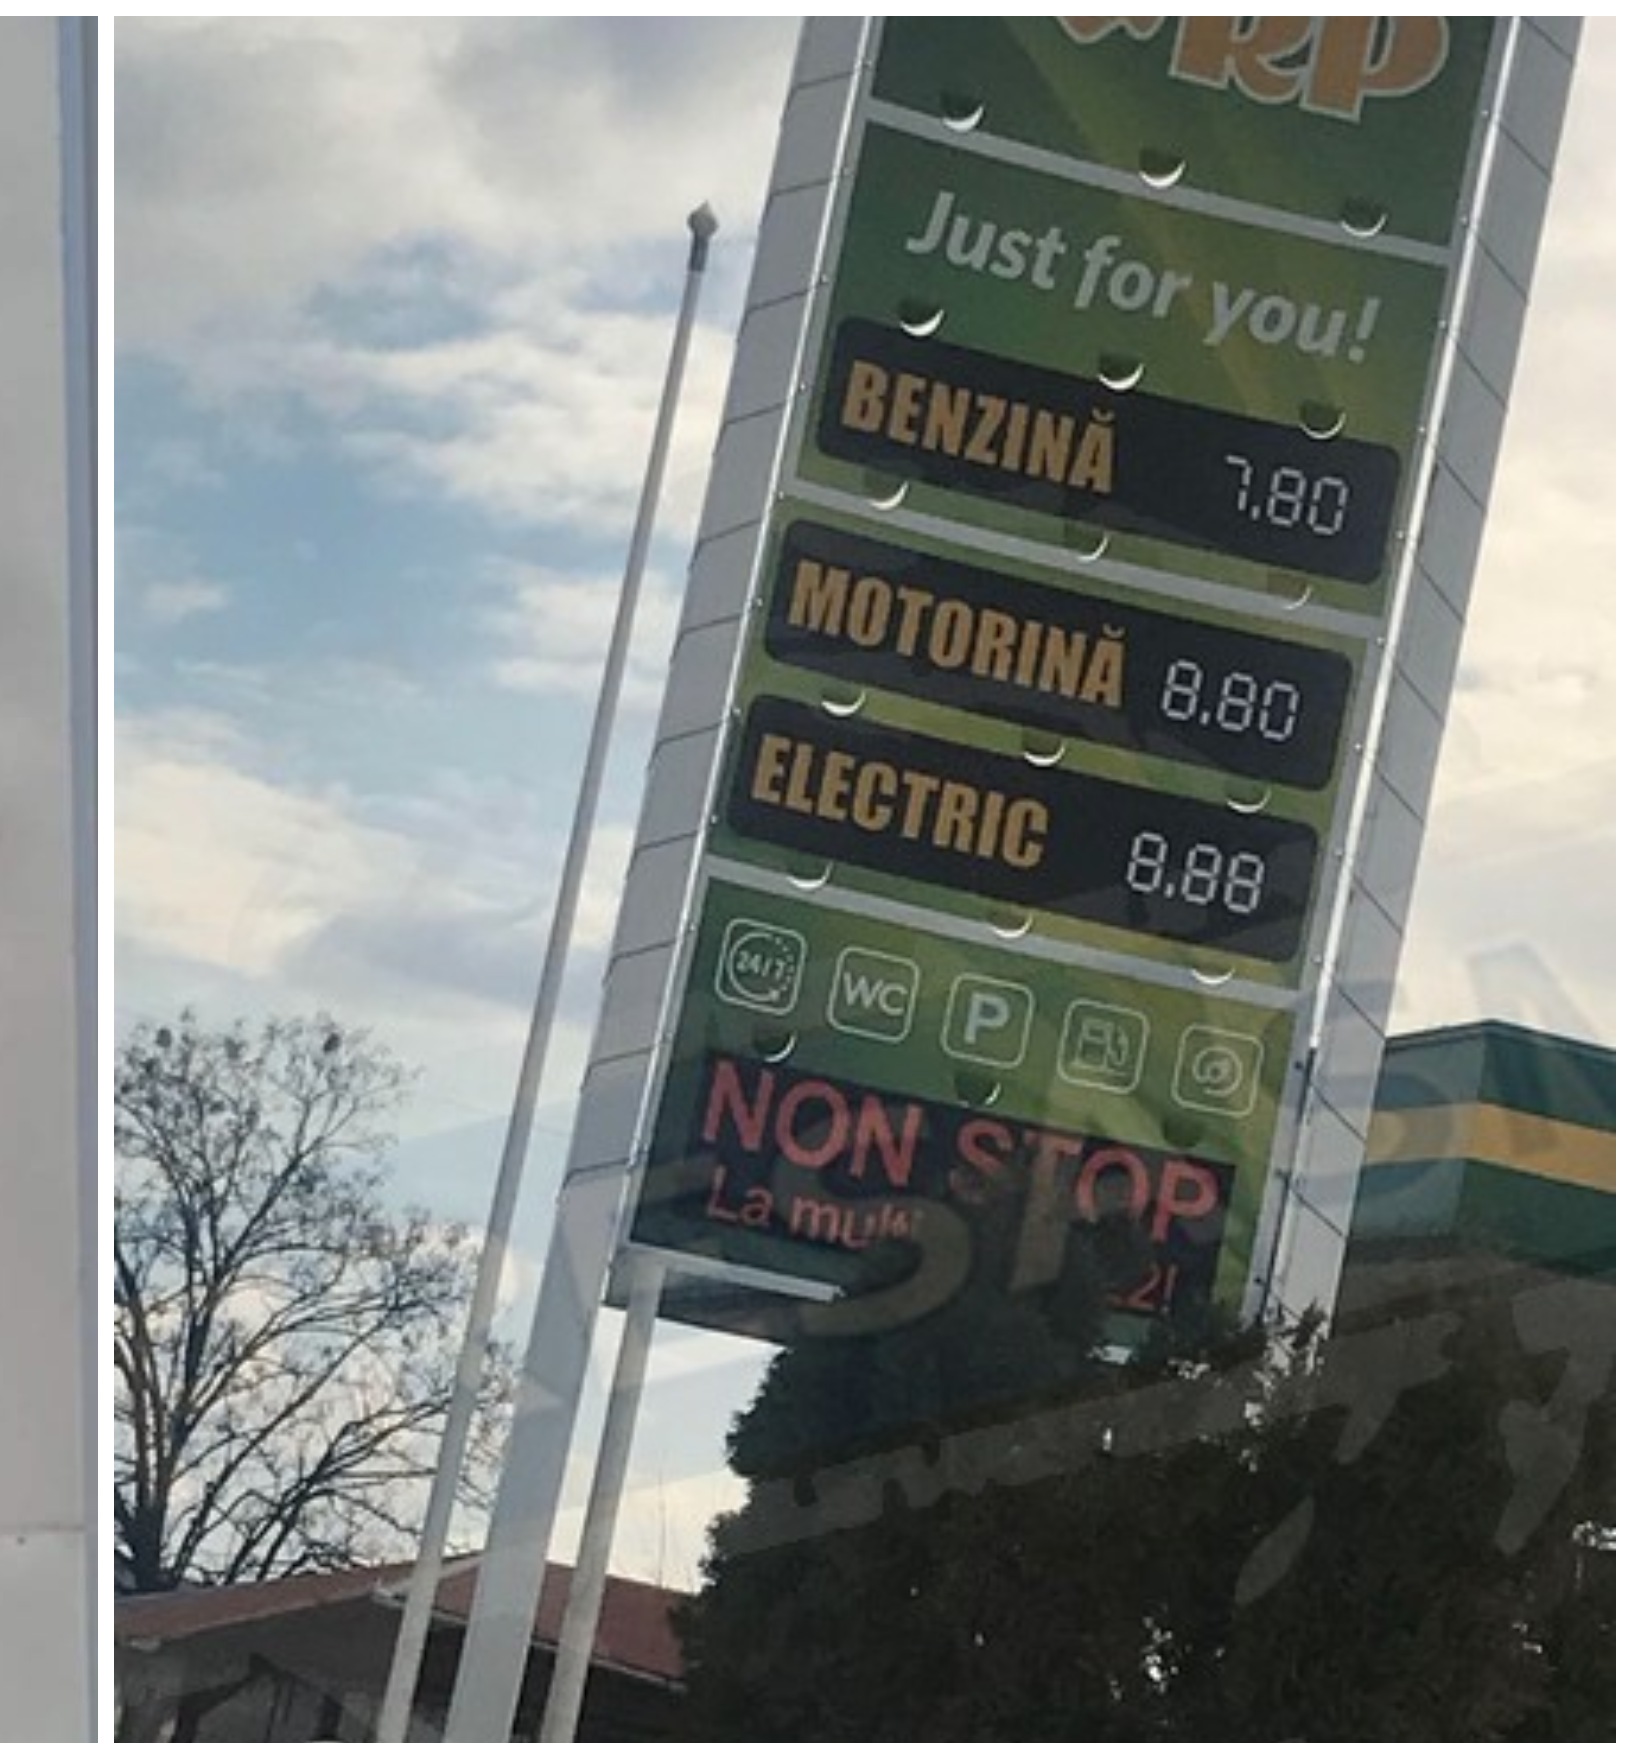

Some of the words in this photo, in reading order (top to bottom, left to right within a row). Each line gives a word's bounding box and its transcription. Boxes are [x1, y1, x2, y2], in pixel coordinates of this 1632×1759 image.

[906, 191, 1067, 291] Just
[1074, 234, 1191, 318] for
[1202, 280, 1380, 363] you!
[841, 360, 1118, 494] BENZINĂ
[1225, 454, 1350, 537] 7.80
[786, 561, 1126, 709] MOTORINĂ
[1161, 660, 1300, 743] 8.80
[752, 733, 1050, 869] ELECTRIC
[1125, 832, 1268, 914] 8.88
[735, 950, 785, 981] 24/7
[843, 971, 909, 1016] WC
[964, 993, 1010, 1044] P
[702, 1059, 924, 1187] NON
[949, 1120, 1223, 1243] STOP
[707, 1164, 770, 1229] La
